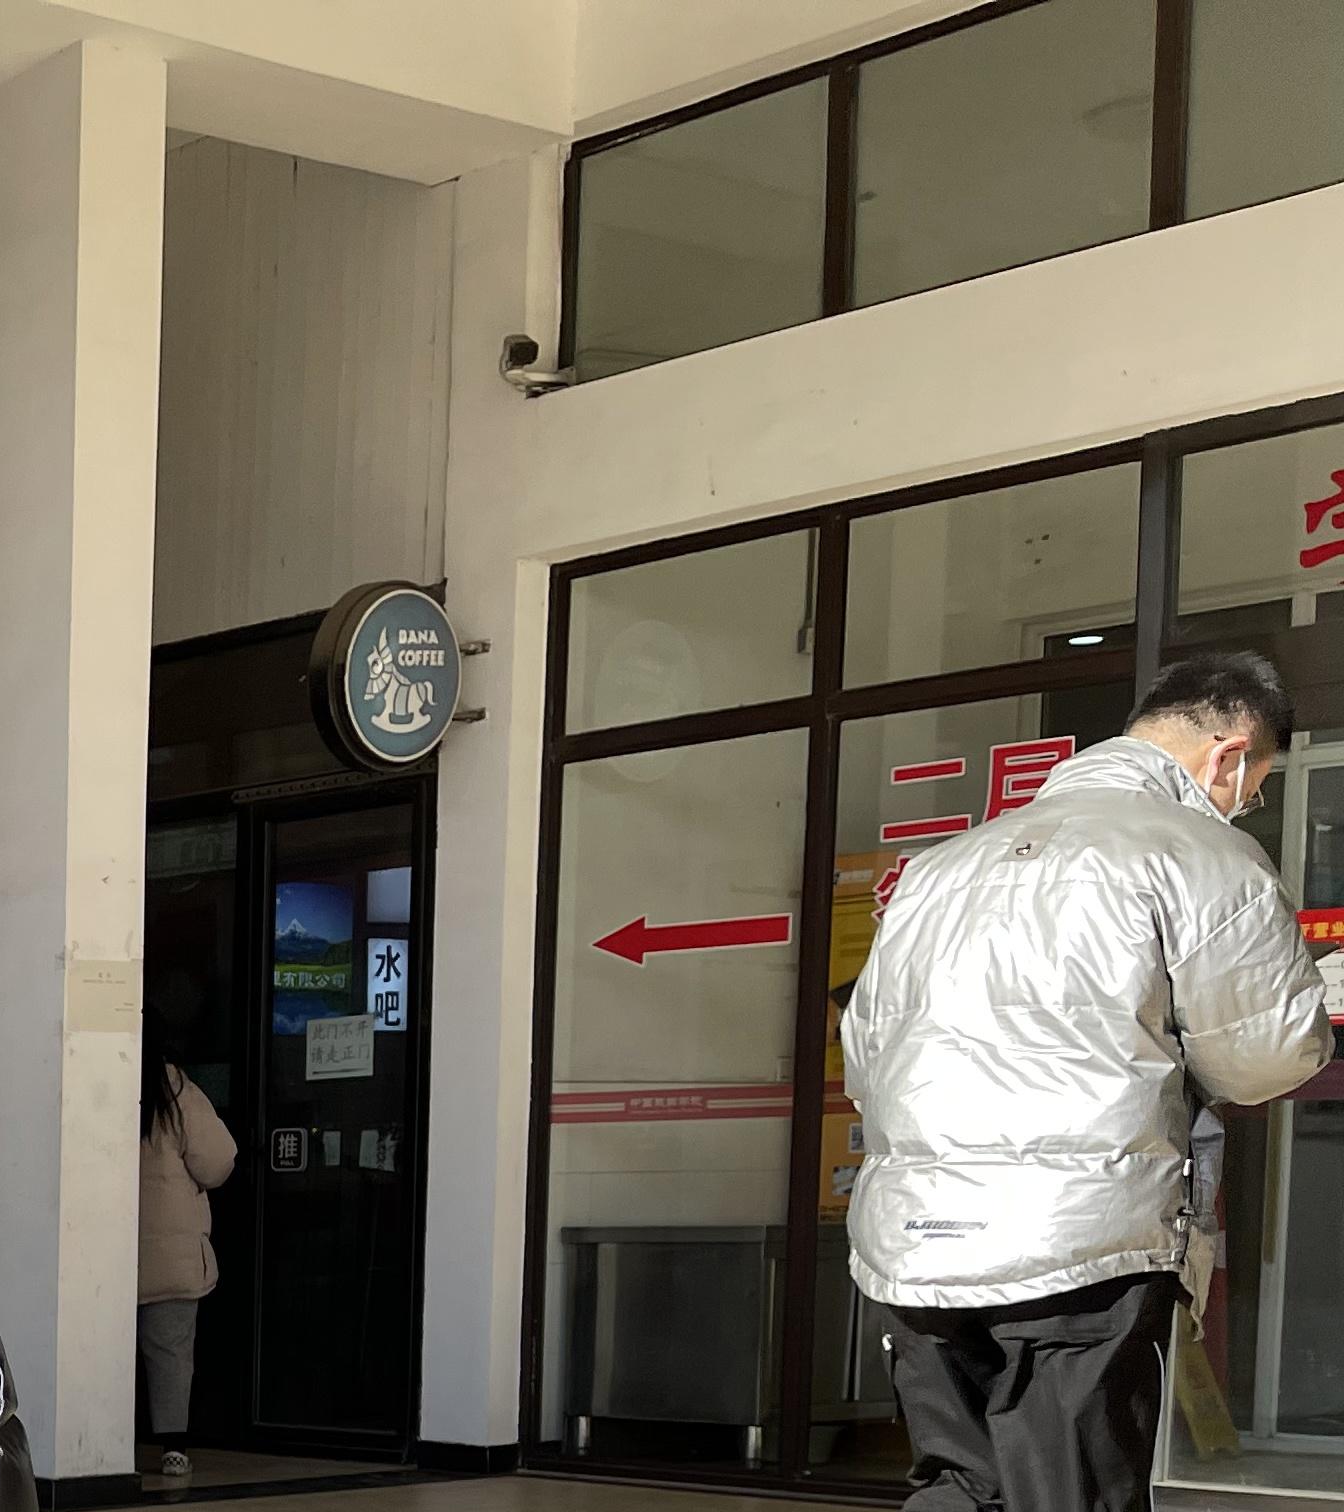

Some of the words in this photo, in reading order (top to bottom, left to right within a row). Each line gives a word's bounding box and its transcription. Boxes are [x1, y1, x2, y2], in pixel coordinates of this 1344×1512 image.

[397, 649, 446, 667] COFFEE
[375, 944, 402, 1027] 水吧
[278, 1133, 299, 1160] 推
